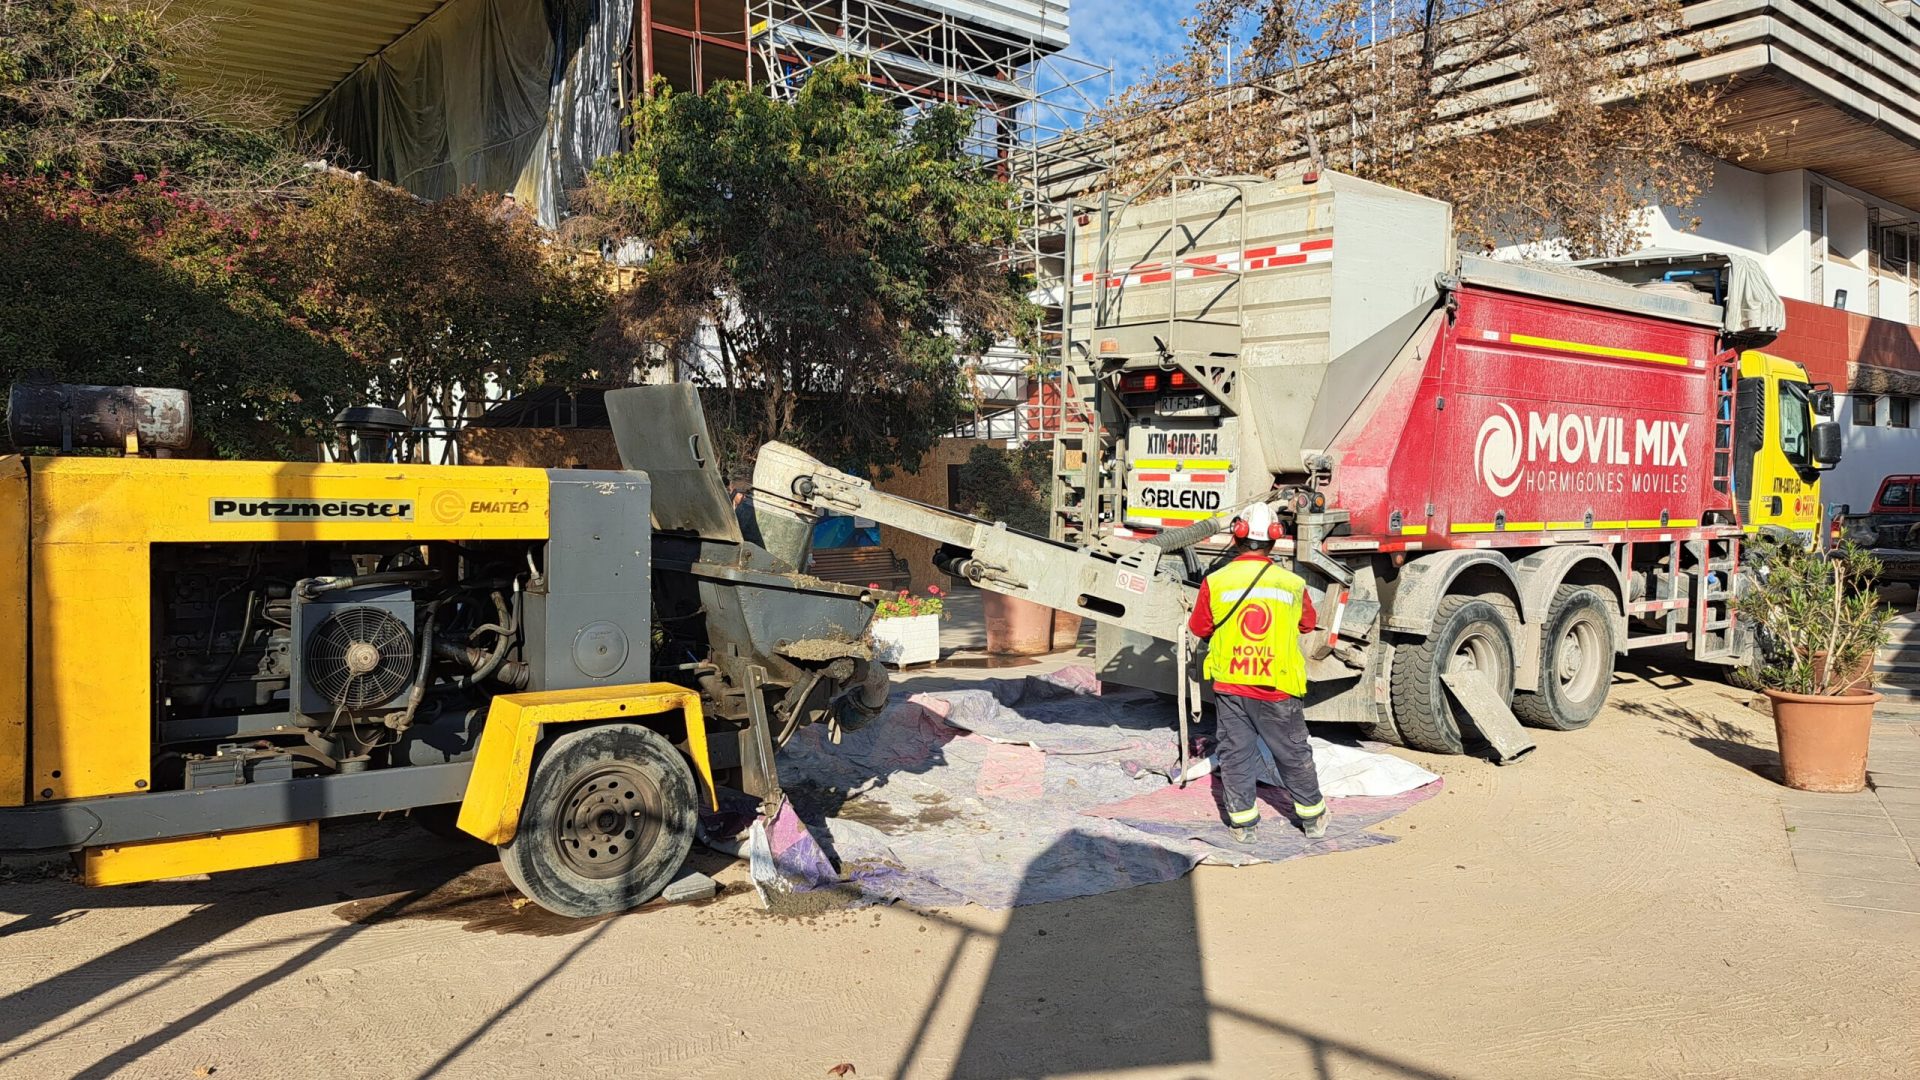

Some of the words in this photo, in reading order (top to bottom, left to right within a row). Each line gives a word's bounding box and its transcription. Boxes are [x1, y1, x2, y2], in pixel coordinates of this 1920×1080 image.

[1527, 411, 1630, 465] MOVIL
[1634, 419, 1690, 467] MIX
[1526, 470, 1624, 493] HORMIGONES
[1632, 473, 1688, 493] MOVILES
[214, 500, 410, 517] Putzmeister
[1156, 488, 1220, 510] BLEND
[1801, 503, 1815, 516] MIX
[1232, 645, 1275, 658] MOVIL
[1229, 657, 1273, 677] MIX
